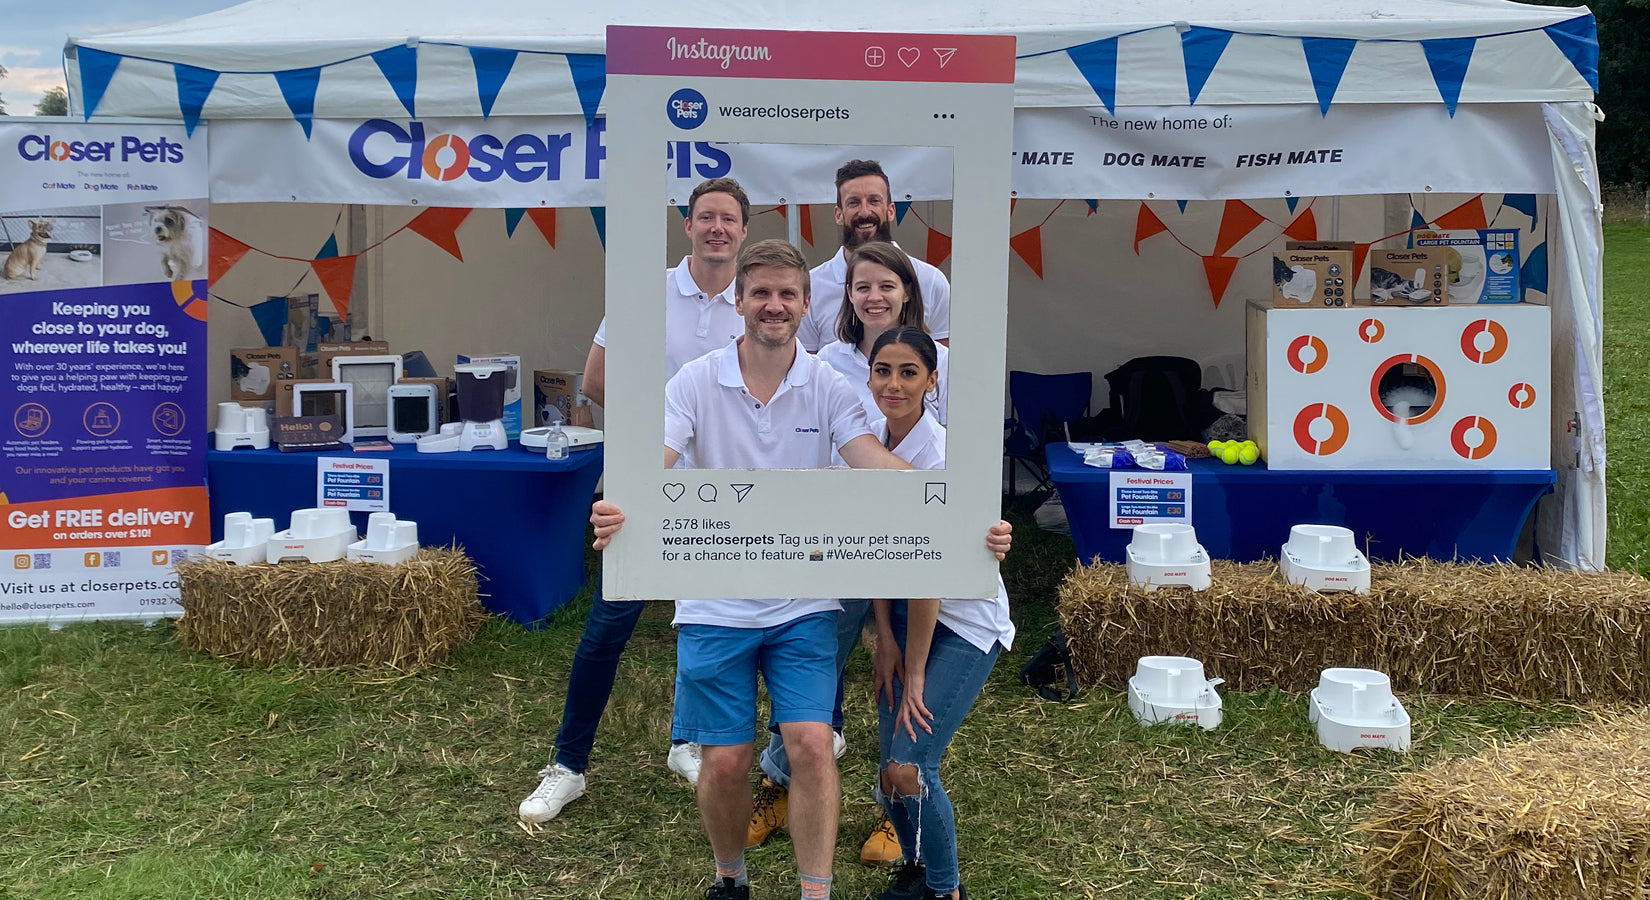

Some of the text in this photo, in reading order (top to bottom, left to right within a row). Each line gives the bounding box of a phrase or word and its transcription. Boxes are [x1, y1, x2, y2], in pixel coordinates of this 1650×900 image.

[667, 36, 772, 69] Instagram
[672, 100, 703, 110] Closer
[677, 109, 698, 118] Pets
[719, 104, 850, 121] wearecloserpets
[1090, 116, 1232, 130] The new home of:
[18, 134, 184, 164] Closer Pets
[348, 118, 571, 182] Closer
[1022, 150, 1343, 168] MATE DOG MATE FISH MATE
[52, 302, 150, 318] Keeping you
[32, 322, 169, 338] close to your dog,
[12, 341, 187, 357] wherever life takes you!
[14, 363, 34, 371] With
[56, 363, 68, 371] 30
[96, 364, 144, 373] experience,
[21, 374, 39, 382] give
[66, 373, 98, 383] helping
[99, 374, 118, 383] paw
[119, 373, 137, 381] with
[139, 373, 170, 383] keeping
[556, 377, 566, 386] Pets
[17, 384, 38, 393] dogs
[39, 384, 57, 392] fed,
[58, 384, 99, 393] hydrated,
[100, 384, 132, 393] healthy
[158, 384, 183, 393] happy!
[280, 423, 313, 431] Hello!
[16, 466, 31, 474] Our
[34, 466, 76, 474] innovative
[79, 466, 93, 475] pet
[95, 465, 131, 475] products
[155, 466, 170, 474] got
[68, 477, 86, 486] your
[118, 475, 154, 483] covered.
[8, 508, 194, 529] Get FREE delivery
[662, 519, 731, 532] 2,578 likes
[53, 529, 151, 540] on orders over £10!
[662, 534, 930, 548] wearecloserpets Tag us in your pet snaps
[662, 548, 942, 561] for a chance to feature #WeAreCloserPets
[1, 579, 178, 594] Visit us at closerpets.co
[0, 600, 95, 610] hello@closerpets.com
